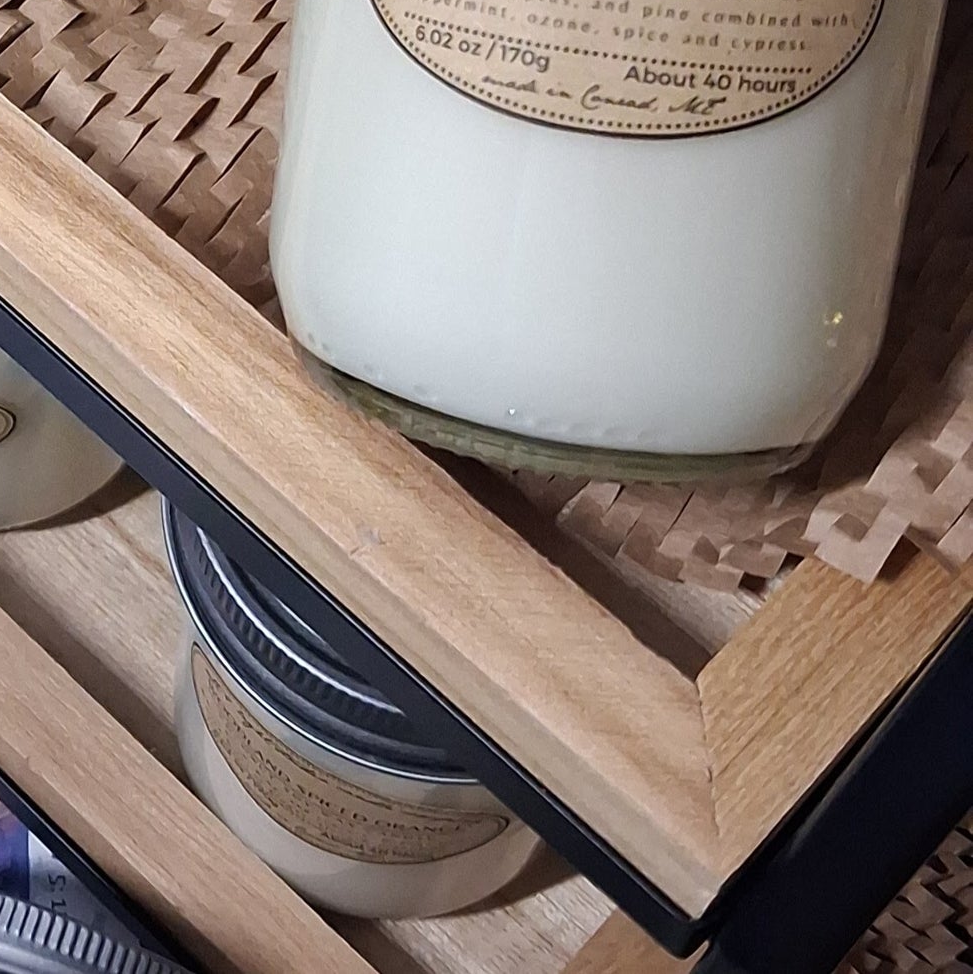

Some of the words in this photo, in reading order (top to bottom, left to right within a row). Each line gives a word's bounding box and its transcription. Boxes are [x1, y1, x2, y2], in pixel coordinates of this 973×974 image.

[642, 2, 689, 21] pine
[701, 12, 802, 29] combined
[811, 12, 849, 28] with
[612, 25, 669, 44] spice
[682, 32, 719, 48] and
[458, 39, 481, 56] oz
[624, 64, 696, 89] About
[703, 73, 732, 91] 40
[737, 75, 797, 94] hours
